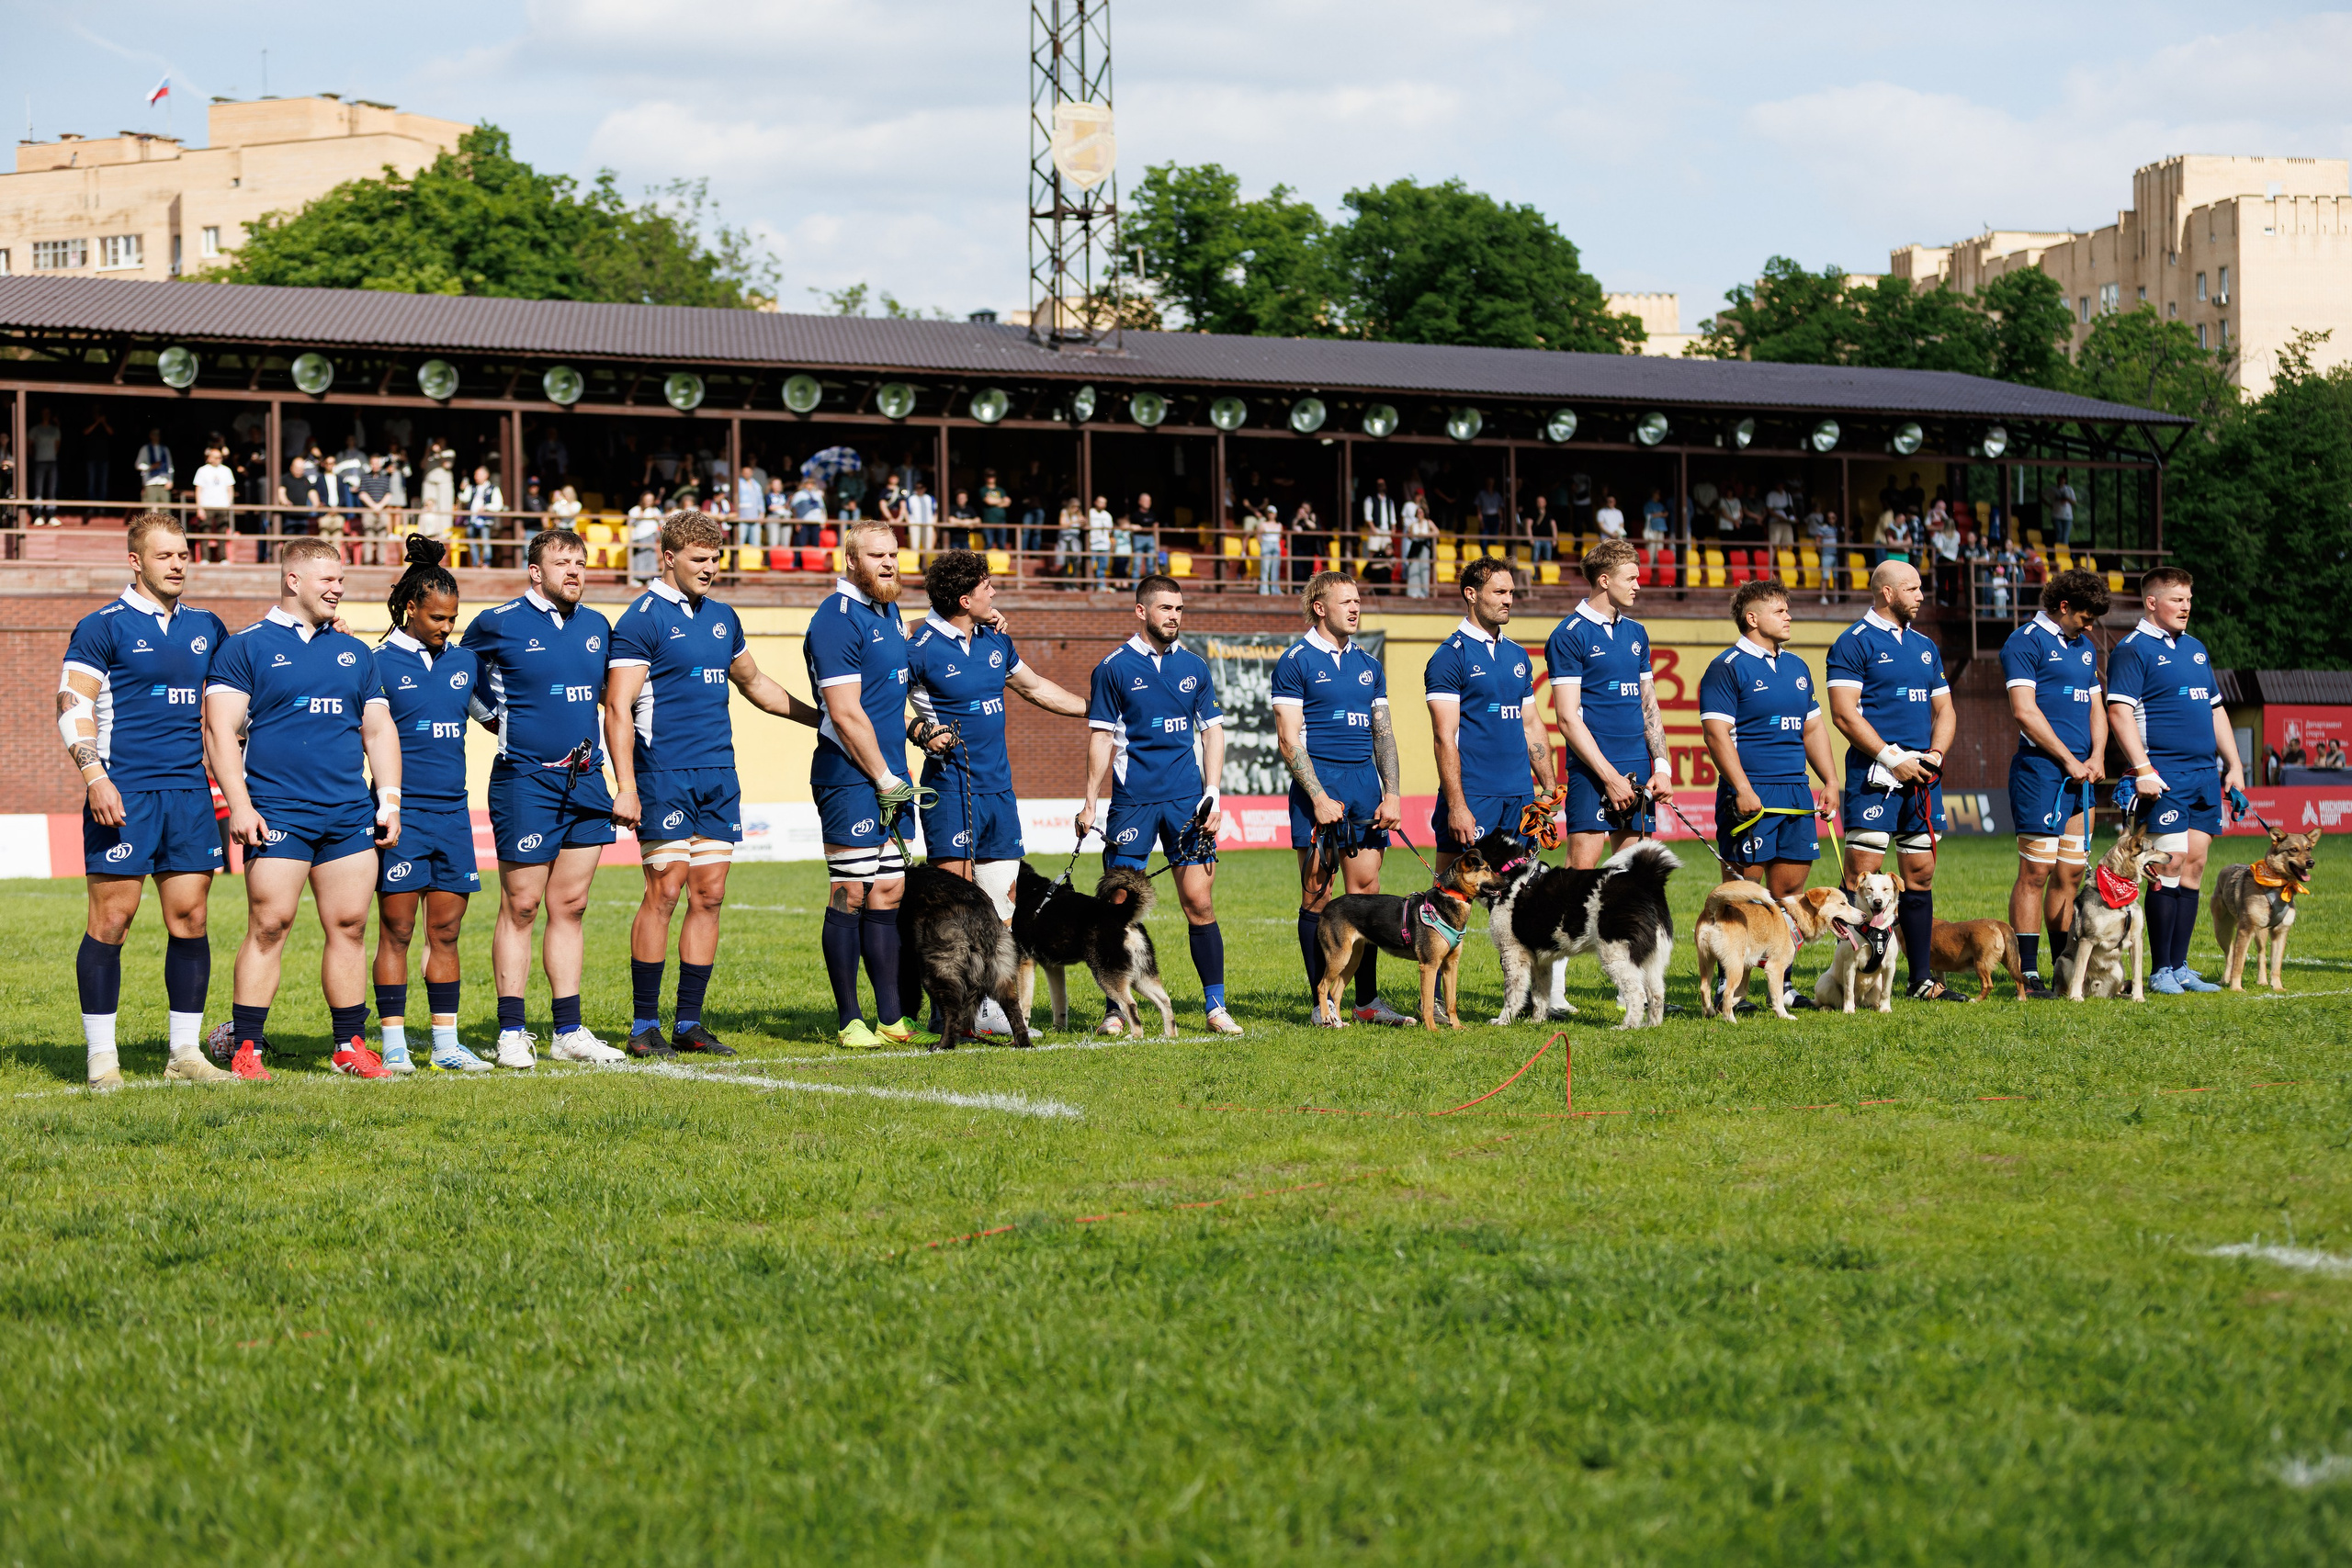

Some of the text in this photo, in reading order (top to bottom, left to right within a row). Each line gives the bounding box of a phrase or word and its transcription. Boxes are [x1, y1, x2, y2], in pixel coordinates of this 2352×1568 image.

[703, 668, 726, 684] ВТБ
[167, 687, 197, 705] ВТБ
[565, 684, 593, 703] ВТБ
[1620, 682, 1639, 696] ВТБ
[2074, 688, 2089, 703] ВТБ
[2188, 687, 2209, 700] ВТБ
[306, 696, 344, 715] ВТБ
[981, 697, 1004, 716] ВТБ
[1500, 705, 1521, 719] ВТБ
[1163, 716, 1188, 734] ВТБ
[1347, 712, 1370, 728] ВТБ
[1781, 716, 1802, 730] ВТБ
[432, 722, 460, 739] ВТБ
